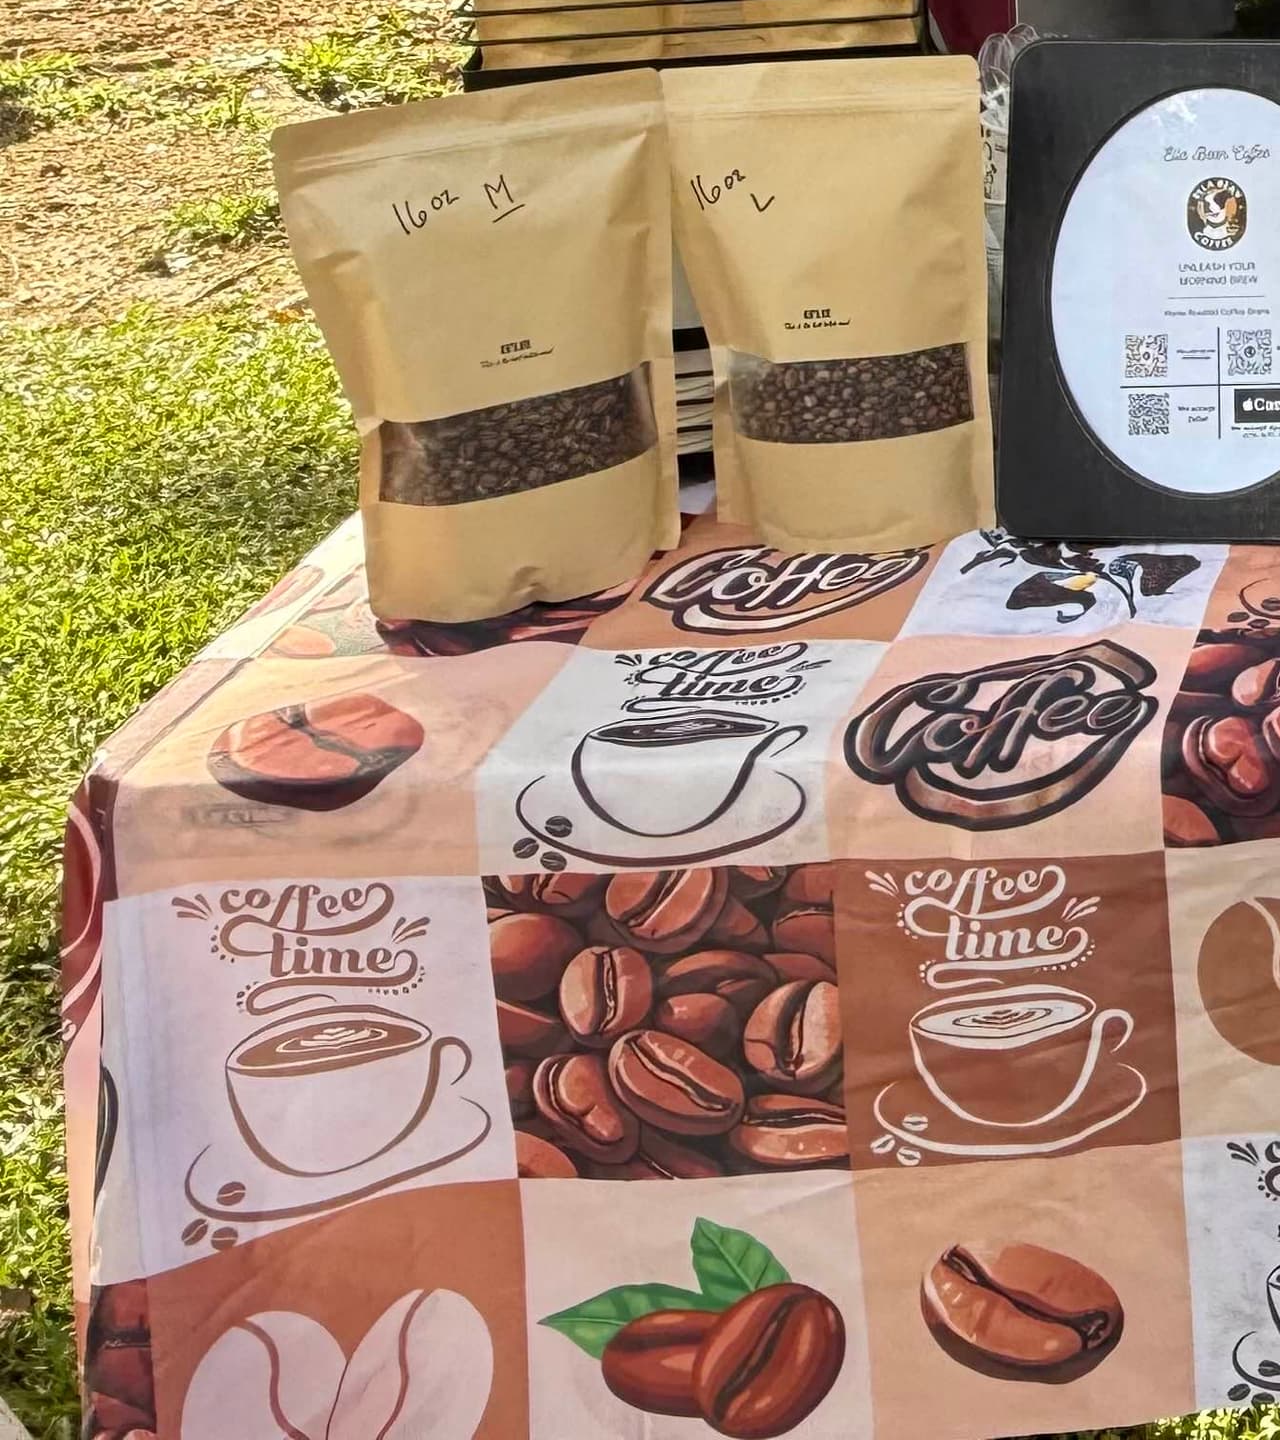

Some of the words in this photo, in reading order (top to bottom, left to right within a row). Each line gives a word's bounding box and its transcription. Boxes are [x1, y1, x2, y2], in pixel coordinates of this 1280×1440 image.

[482, 173, 516, 209] M
[639, 546, 931, 634] Coffee
[647, 641, 808, 674] coffee
[655, 669, 806, 697] time
[842, 639, 1159, 831] Coffee
[218, 881, 394, 936] coffee
[904, 865, 1067, 918] coffee
[262, 930, 419, 980] time
[944, 915, 1088, 962] time
